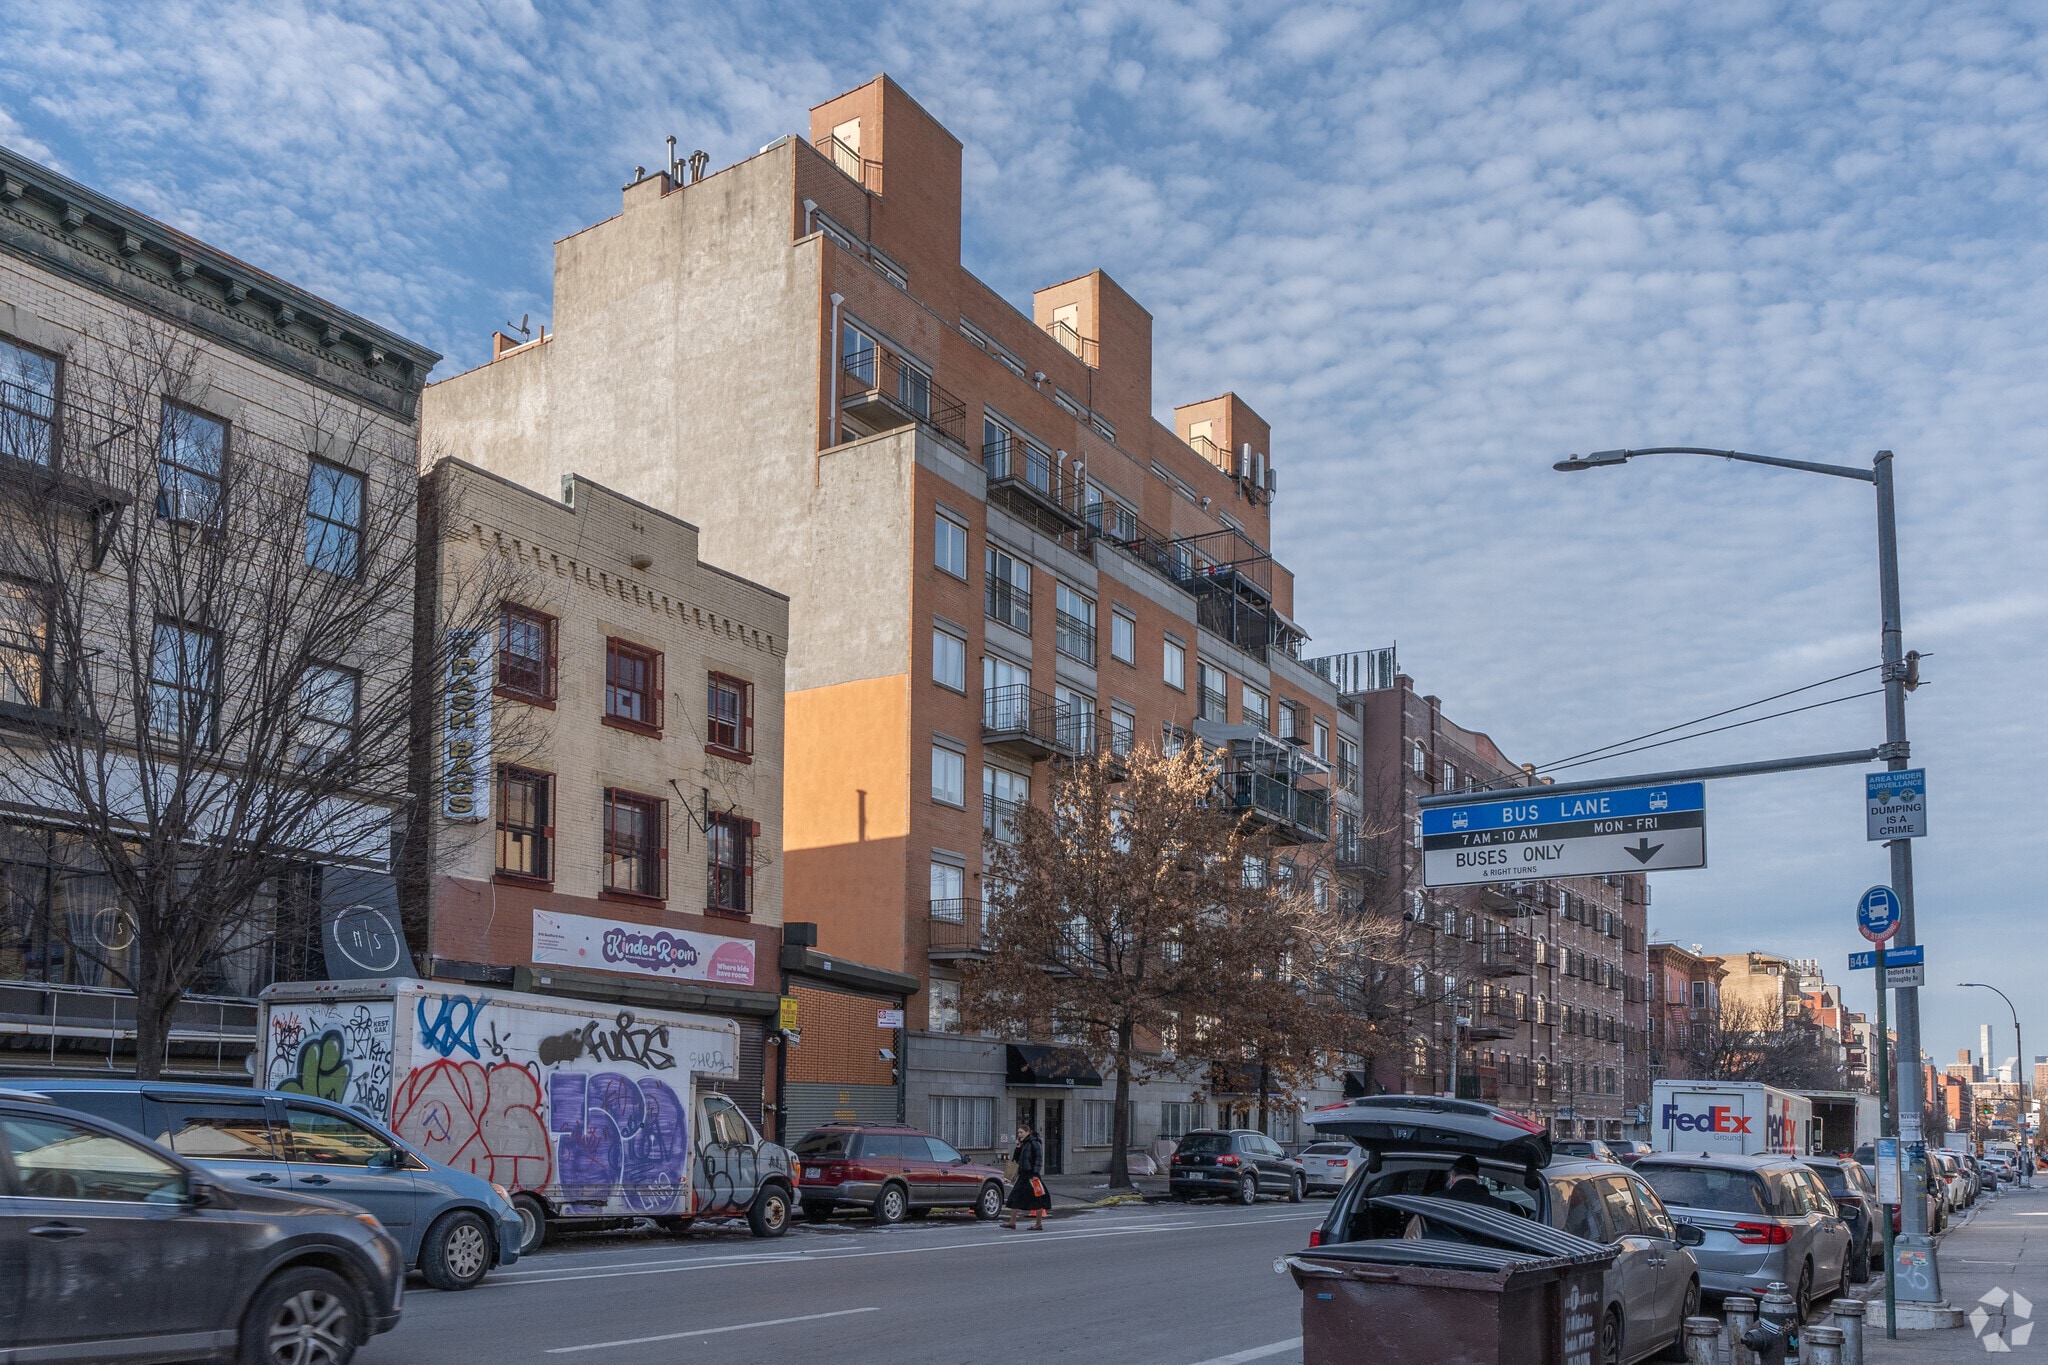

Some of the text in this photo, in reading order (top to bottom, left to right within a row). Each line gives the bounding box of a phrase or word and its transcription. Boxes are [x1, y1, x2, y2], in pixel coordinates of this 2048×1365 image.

[447, 741, 476, 814] BAGS
[1869, 772, 1922, 784] AREA UNDER
[1868, 779, 1923, 791] SURVEILLANCE
[1502, 797, 1611, 823] BUS LANE
[1871, 803, 1922, 815] DUMPING
[1594, 819, 1624, 834] MON
[1636, 817, 1658, 830] FRI
[1886, 815, 1907, 824] IS A
[1879, 824, 1914, 835] CRIME
[1461, 834, 1470, 846] 7
[1472, 832, 1491, 845] AM
[1502, 830, 1515, 842] 10
[1519, 828, 1539, 841] AM
[1456, 844, 1565, 868] BUSES ONLY
[1482, 865, 1538, 877] & RIGHT TURNS
[1861, 923, 1897, 940] NO STANDING
[1886, 949, 1917, 958] Williamsburg
[1849, 954, 1870, 968] B44
[716, 962, 750, 973] Where kids
[716, 969, 731, 978] have
[1887, 968, 1904, 976] Bedford
[1662, 1103, 1753, 1134] FedEx
[1766, 1093, 1797, 1155] FedEx
[1713, 1133, 1742, 1142] Ground
